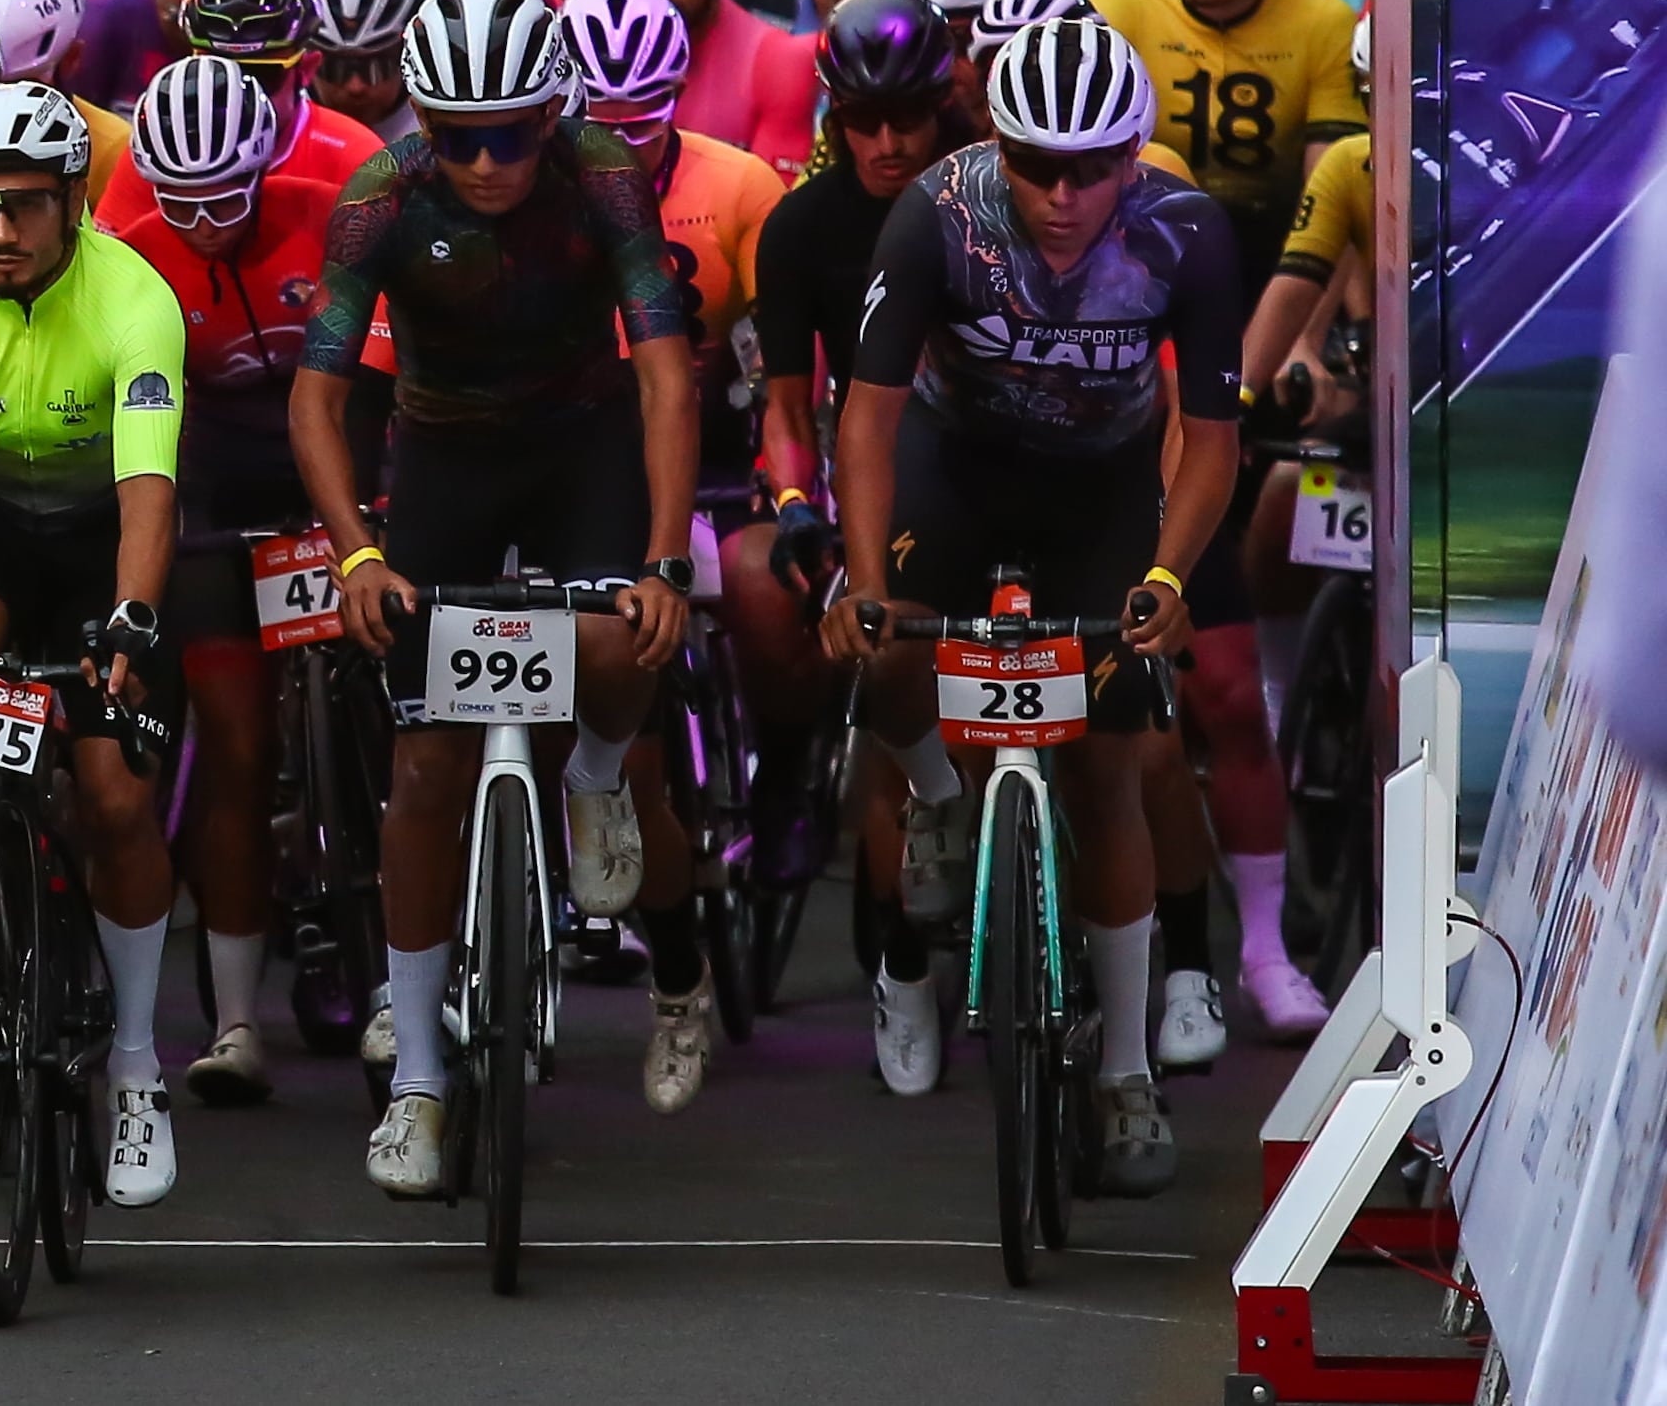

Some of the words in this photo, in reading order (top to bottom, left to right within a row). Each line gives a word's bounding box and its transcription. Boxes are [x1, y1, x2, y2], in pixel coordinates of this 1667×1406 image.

[1168, 68, 1276, 173] 18
[1023, 326, 1148, 345] TRANSPORTES
[1011, 338, 1149, 371] LAIN
[498, 620, 532, 630] GRAN
[450, 648, 554, 694] 996
[1023, 650, 1057, 662] GRAN
[979, 681, 1045, 721] 28
